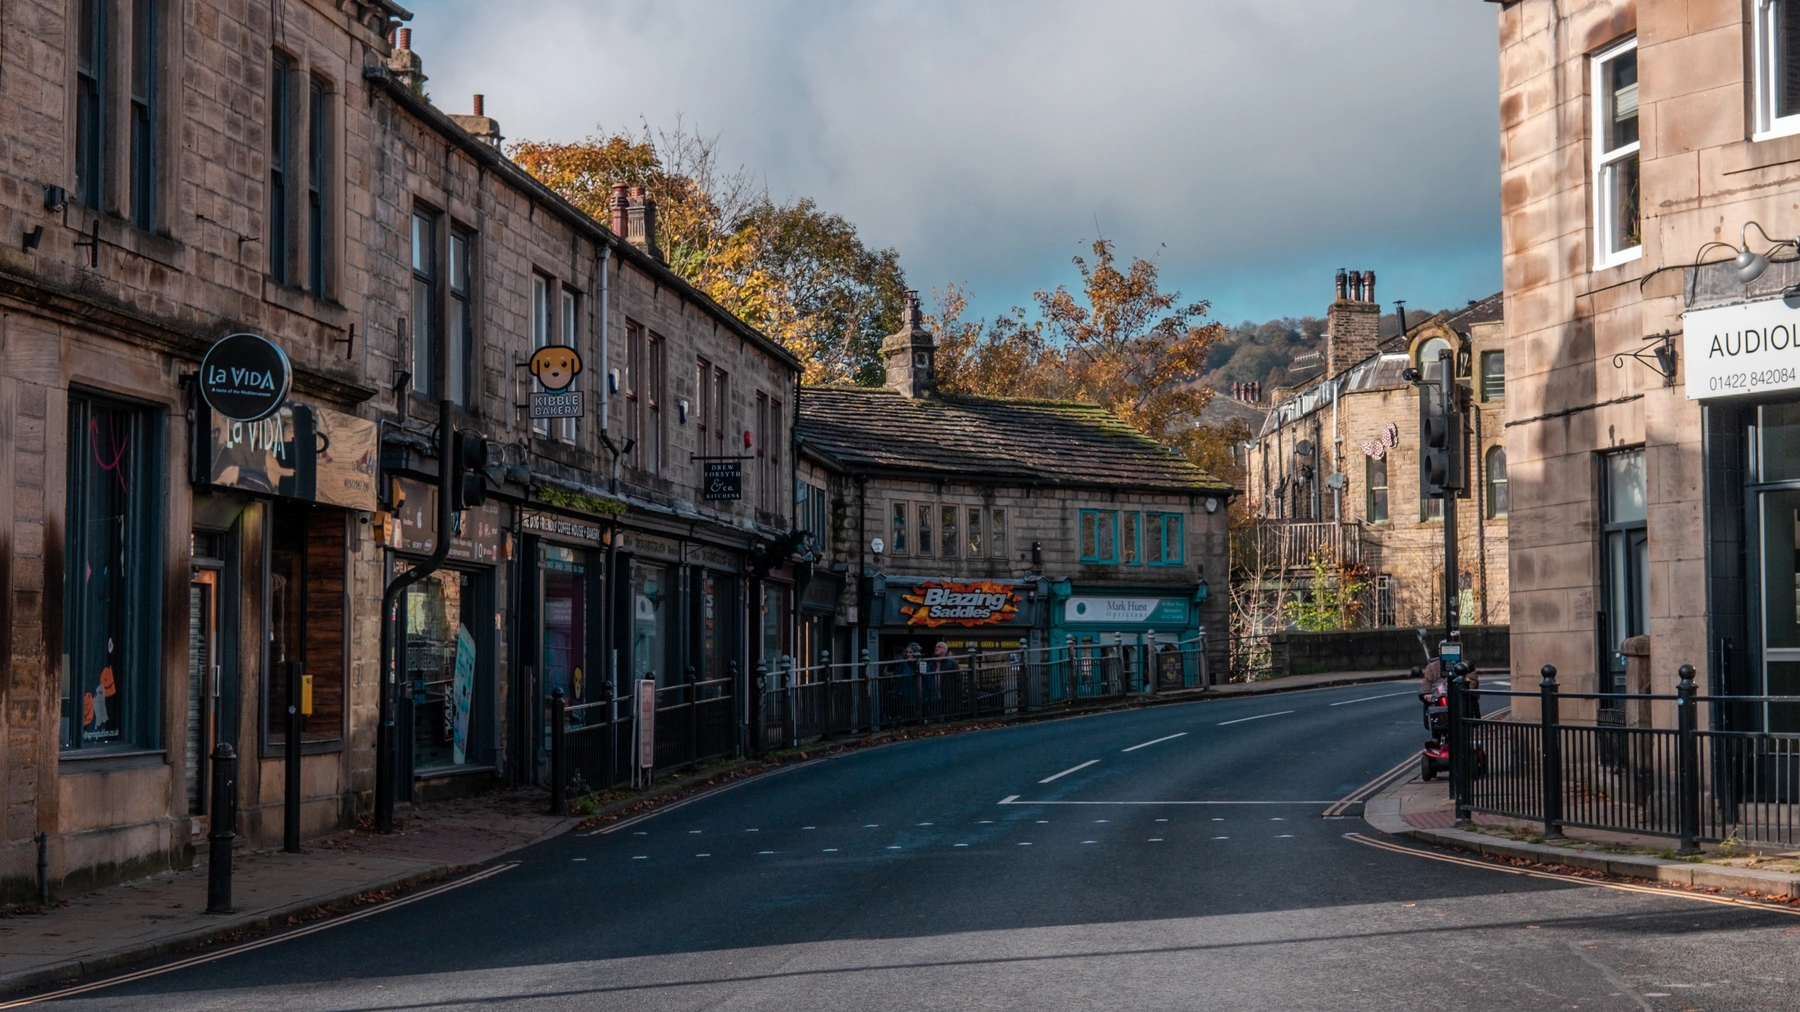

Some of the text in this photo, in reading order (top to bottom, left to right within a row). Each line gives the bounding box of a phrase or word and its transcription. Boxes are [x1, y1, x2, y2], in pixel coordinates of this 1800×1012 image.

[1709, 323, 1800, 359] AUDIOL
[1709, 367, 1796, 391] 01422 842084
[240, 389, 271, 397] Mediterranean
[535, 395, 579, 406] KIBBLE
[535, 405, 579, 415] BAKERY
[557, 520, 571, 536] COFFEE
[571, 523, 584, 538] HOUSE
[924, 588, 1007, 611] Blazing
[1107, 600, 1147, 611] Mark Hurst
[929, 605, 991, 618] Saddles
[1106, 611, 1147, 619] Opticians
